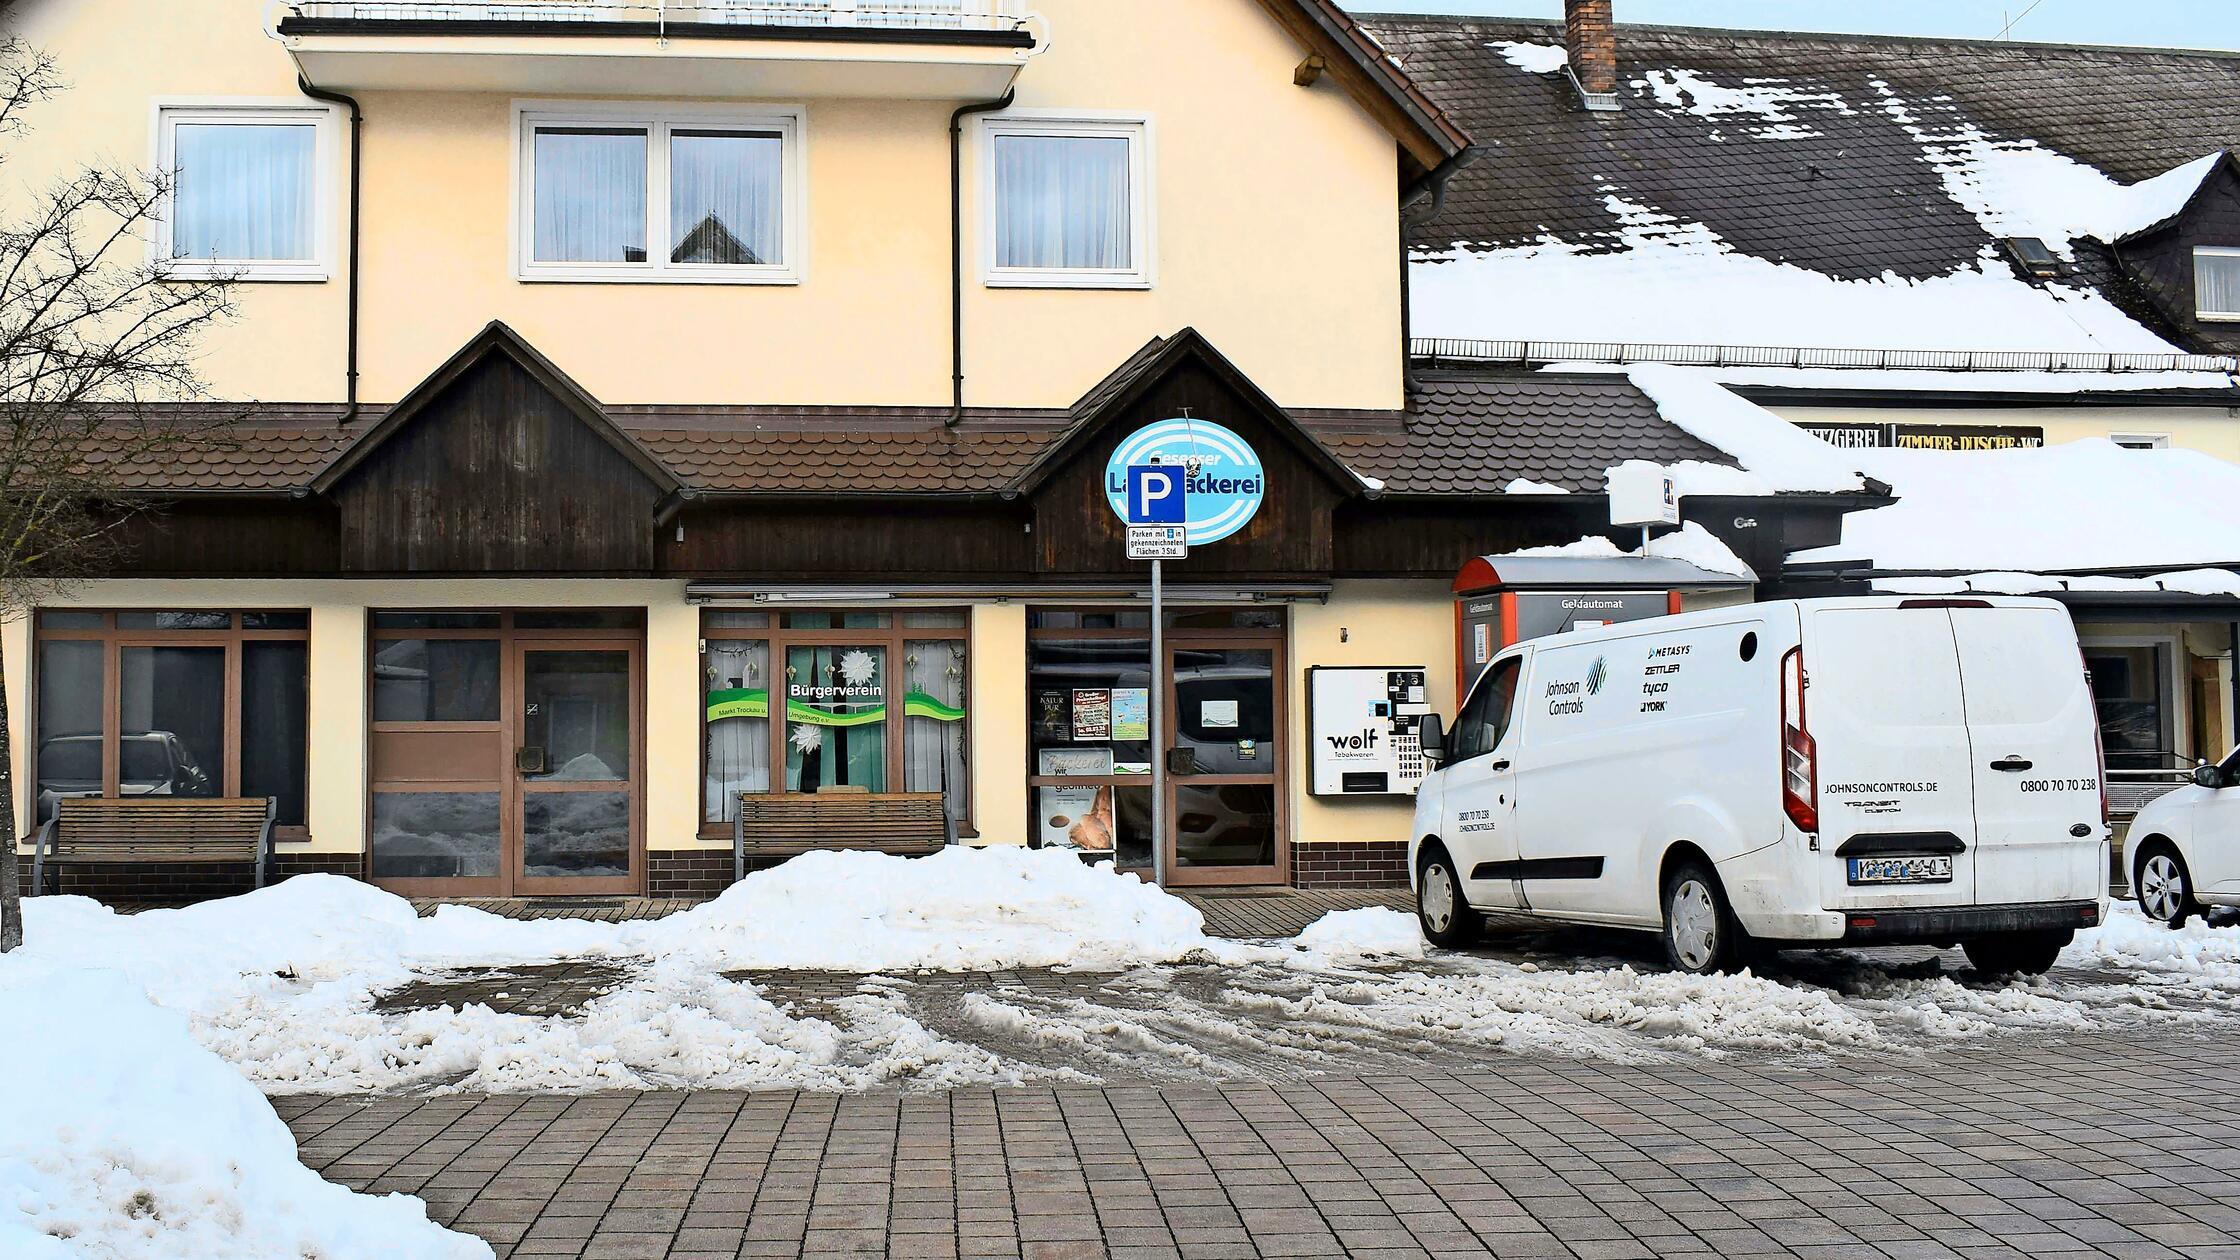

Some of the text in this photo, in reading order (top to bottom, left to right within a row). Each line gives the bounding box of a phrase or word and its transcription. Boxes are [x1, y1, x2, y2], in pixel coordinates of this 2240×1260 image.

[1141, 472, 1172, 516] P
[1132, 530, 1152, 538] Parken
[1130, 540, 1183, 548] gekennzeichneten
[1562, 598, 1624, 609] Geldautomat
[1655, 645, 1690, 658] METASYS
[1645, 664, 1680, 675] ZETTLER
[791, 684, 882, 698] Bürgerverein
[1545, 680, 1580, 698] Johnson
[1642, 682, 1669, 696] tyco
[719, 708, 736, 716] Markt
[1549, 698, 1583, 715] Controls
[1647, 701, 1665, 712] YORK
[788, 711, 819, 722] Umgebung
[1327, 728, 1378, 749] wolf
[1825, 782, 1938, 794] JOHNSONCONTROLS.DE
[2020, 778, 2096, 792] 0800 70 70 238
